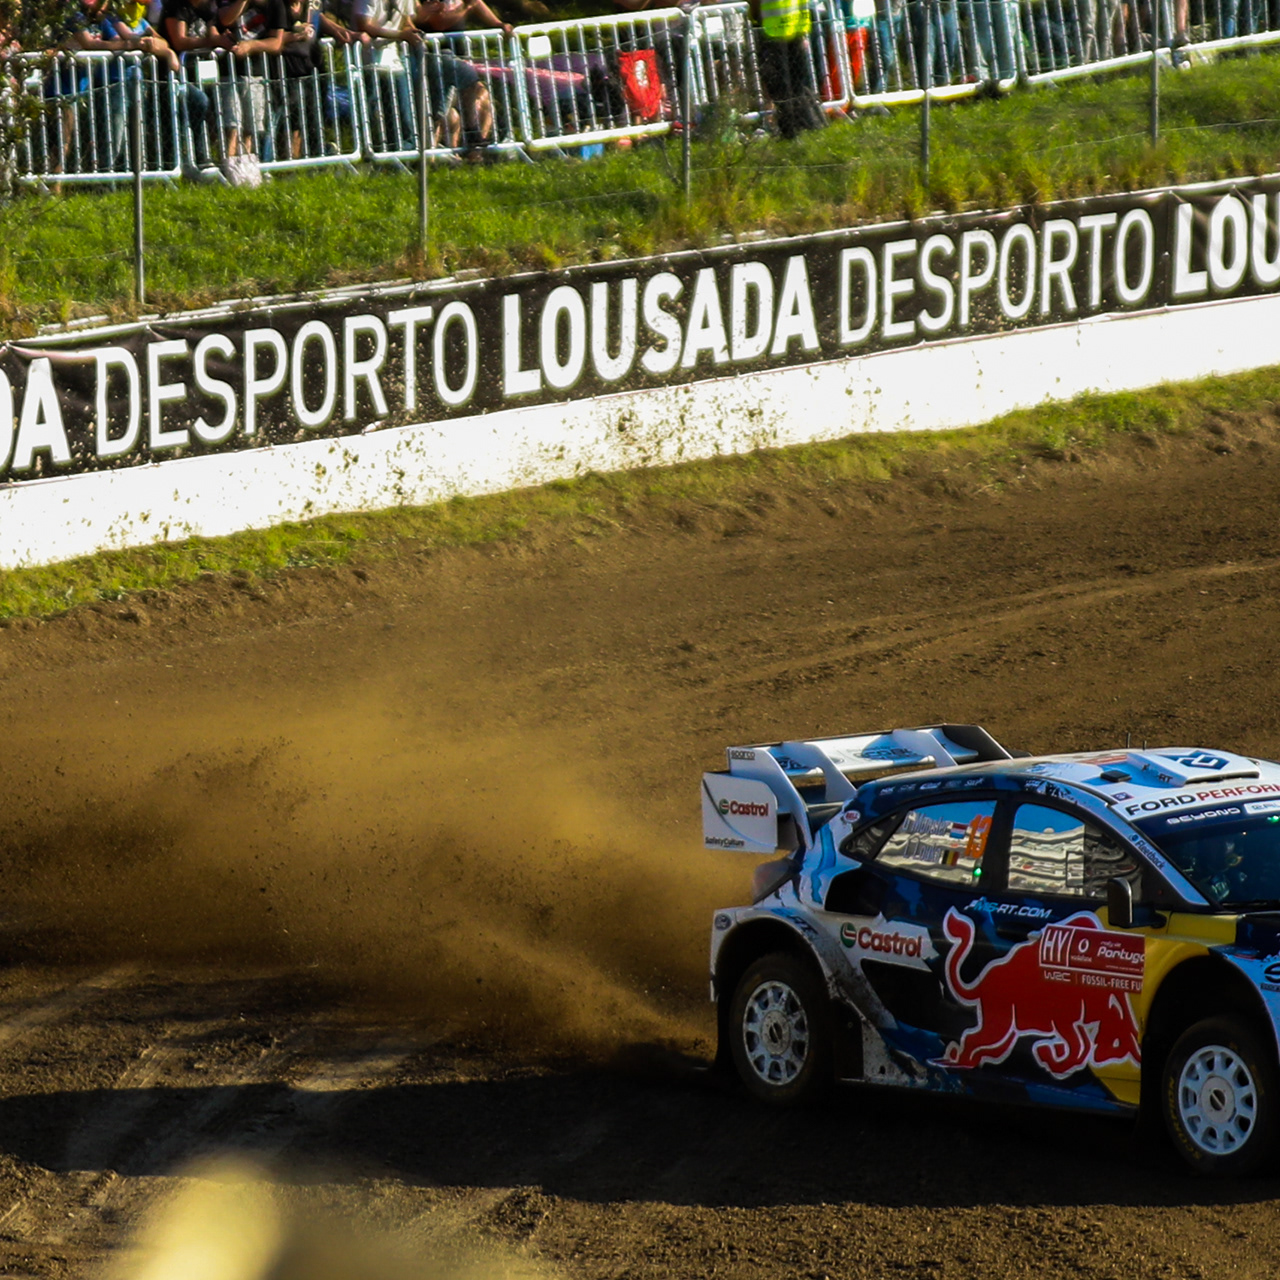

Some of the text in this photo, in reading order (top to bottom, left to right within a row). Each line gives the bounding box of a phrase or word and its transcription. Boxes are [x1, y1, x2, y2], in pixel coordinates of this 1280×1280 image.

[95, 300, 479, 457] DESPORTO
[503, 254, 819, 396] LOUSADA
[839, 208, 1154, 345] DESPORTO
[730, 800, 768, 816] Castrol
[1167, 807, 1241, 824] BEYOND
[964, 814, 992, 859] 13
[857, 926, 923, 958] Castrol
[1043, 928, 1070, 962] HY
